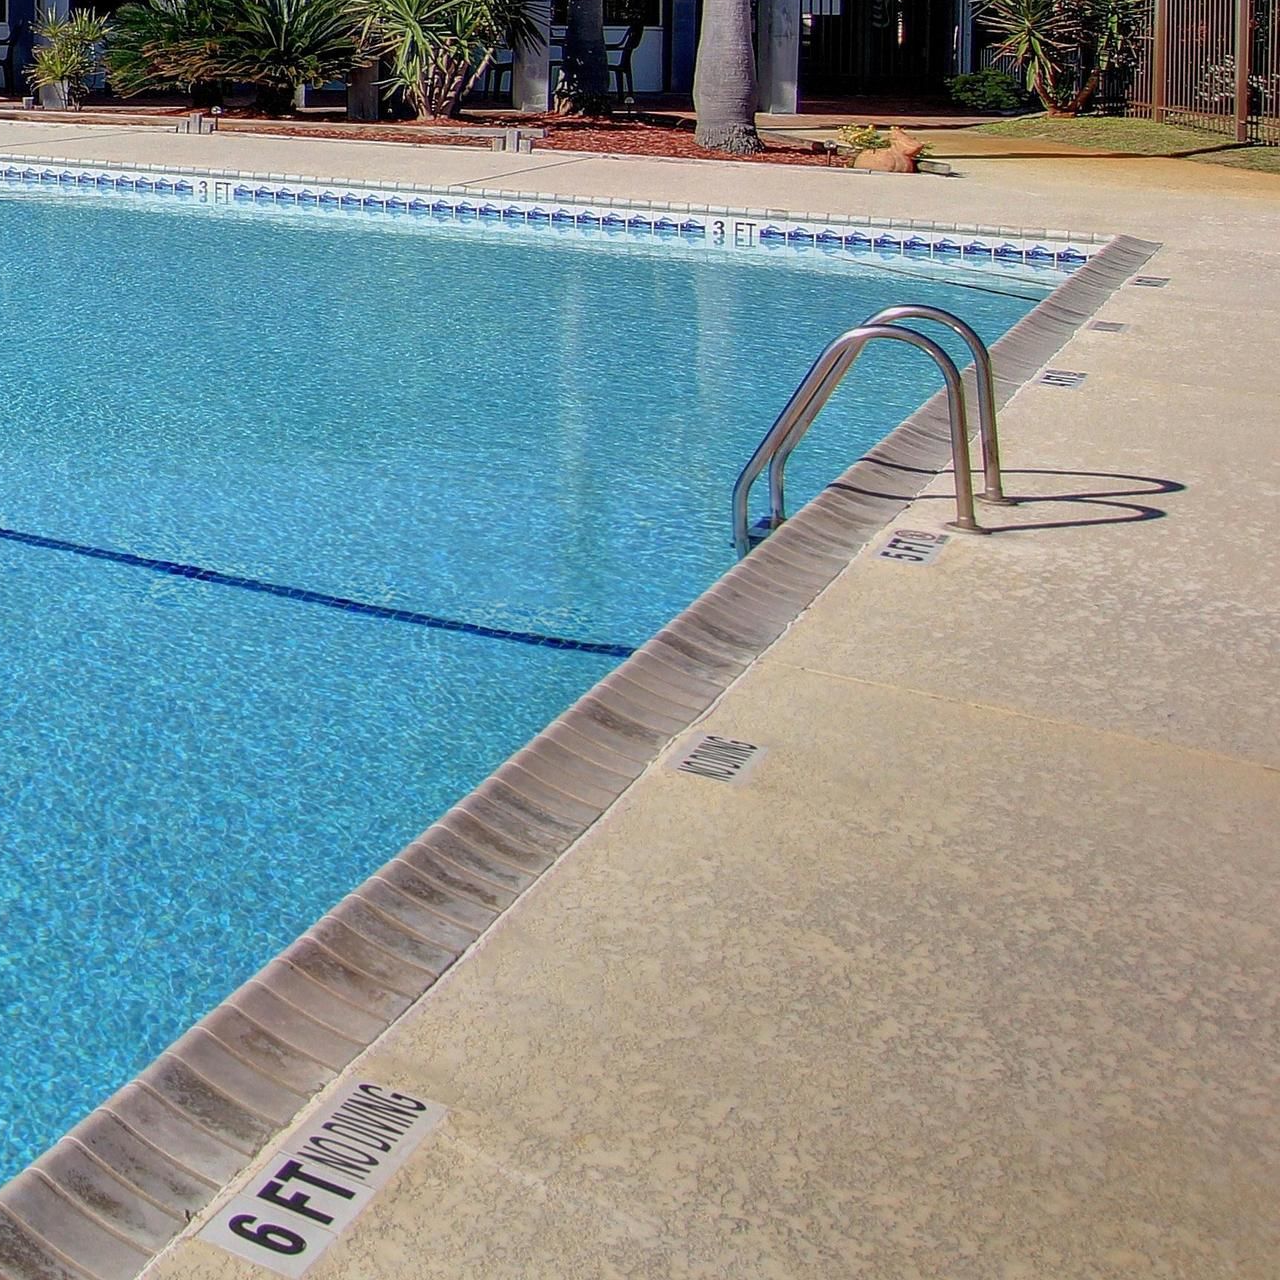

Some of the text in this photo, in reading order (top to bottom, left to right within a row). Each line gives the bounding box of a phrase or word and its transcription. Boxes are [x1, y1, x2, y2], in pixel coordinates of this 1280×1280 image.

[880, 538, 935, 562] 5 FT
[228, 1083, 427, 1255] 6 FT NO DIVING
